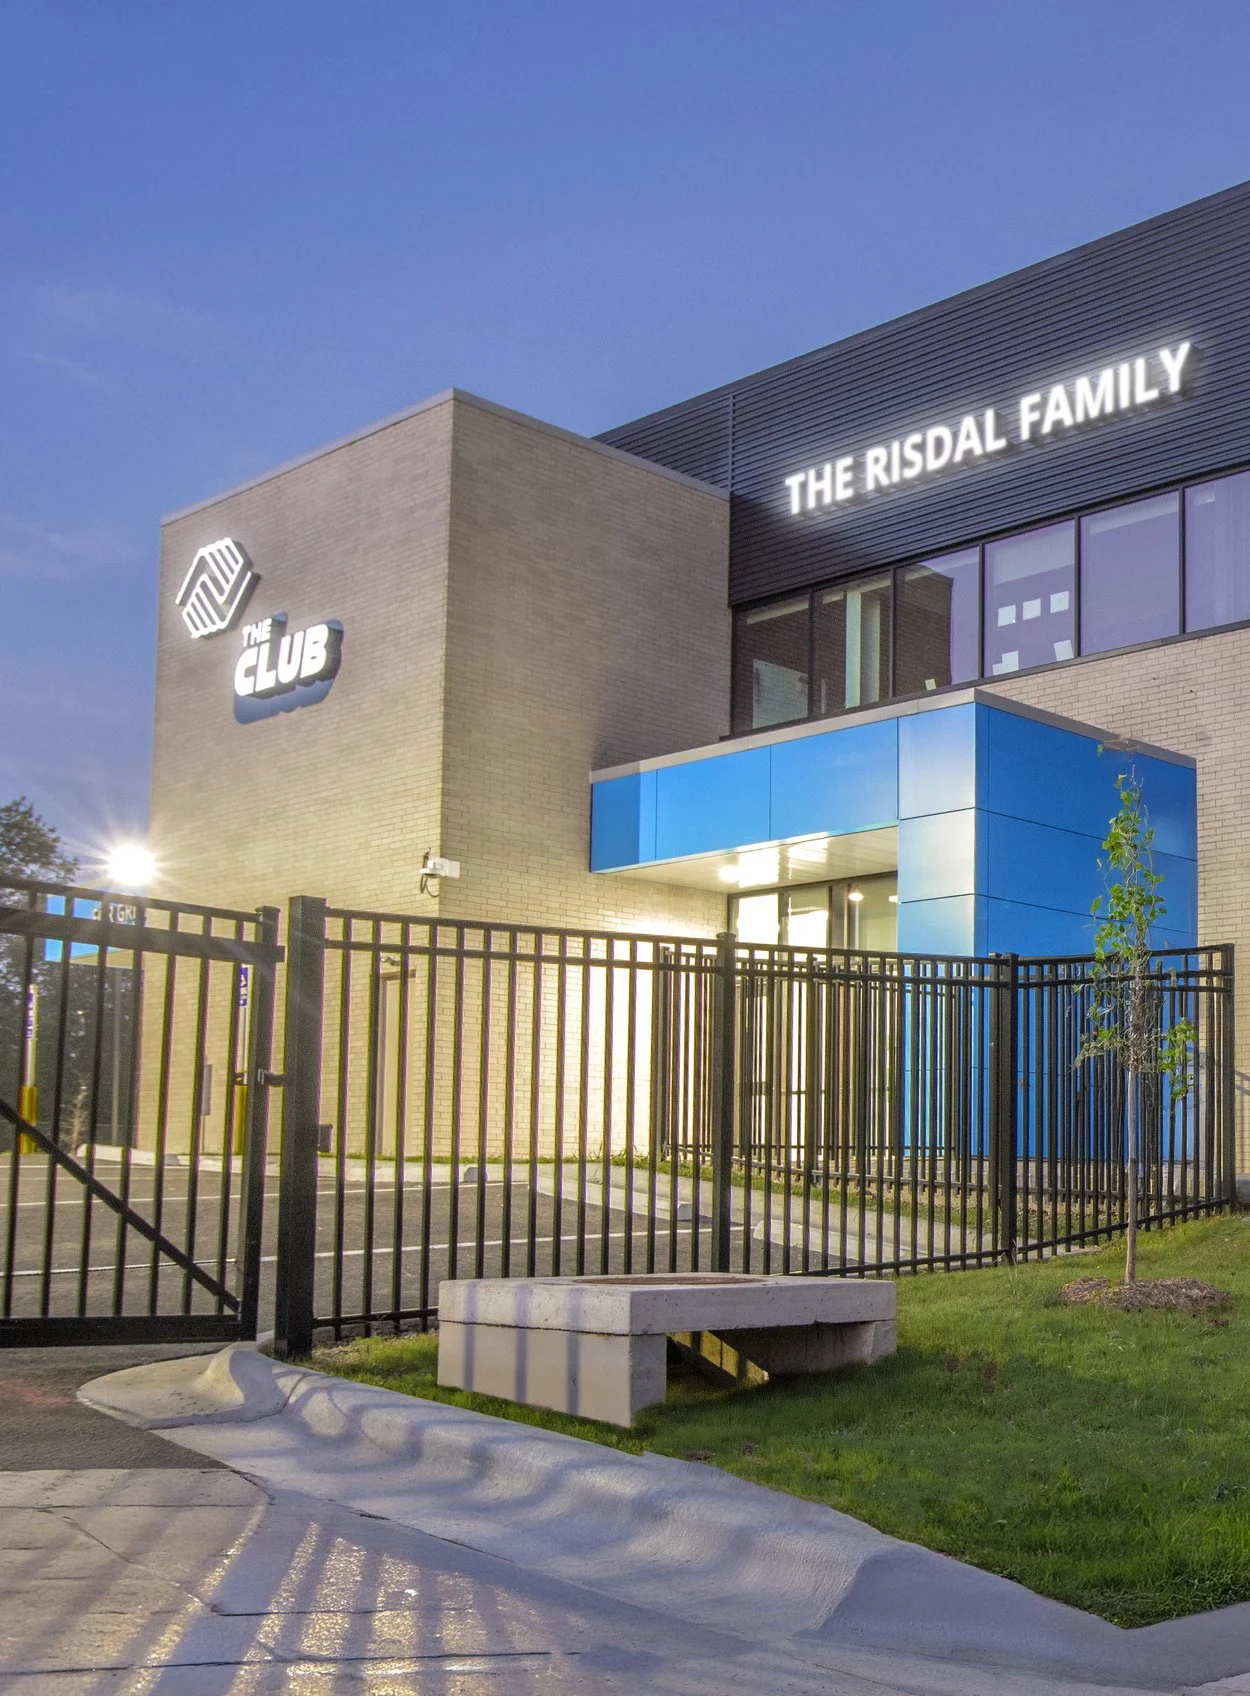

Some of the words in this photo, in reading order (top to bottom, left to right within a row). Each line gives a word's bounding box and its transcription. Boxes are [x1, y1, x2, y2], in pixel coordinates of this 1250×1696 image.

[785, 456, 855, 516] THE
[865, 408, 1007, 491] RISDAL
[1019, 341, 1191, 441] FAMILY
[234, 623, 329, 697] CLUB
[242, 617, 273, 648] THE
